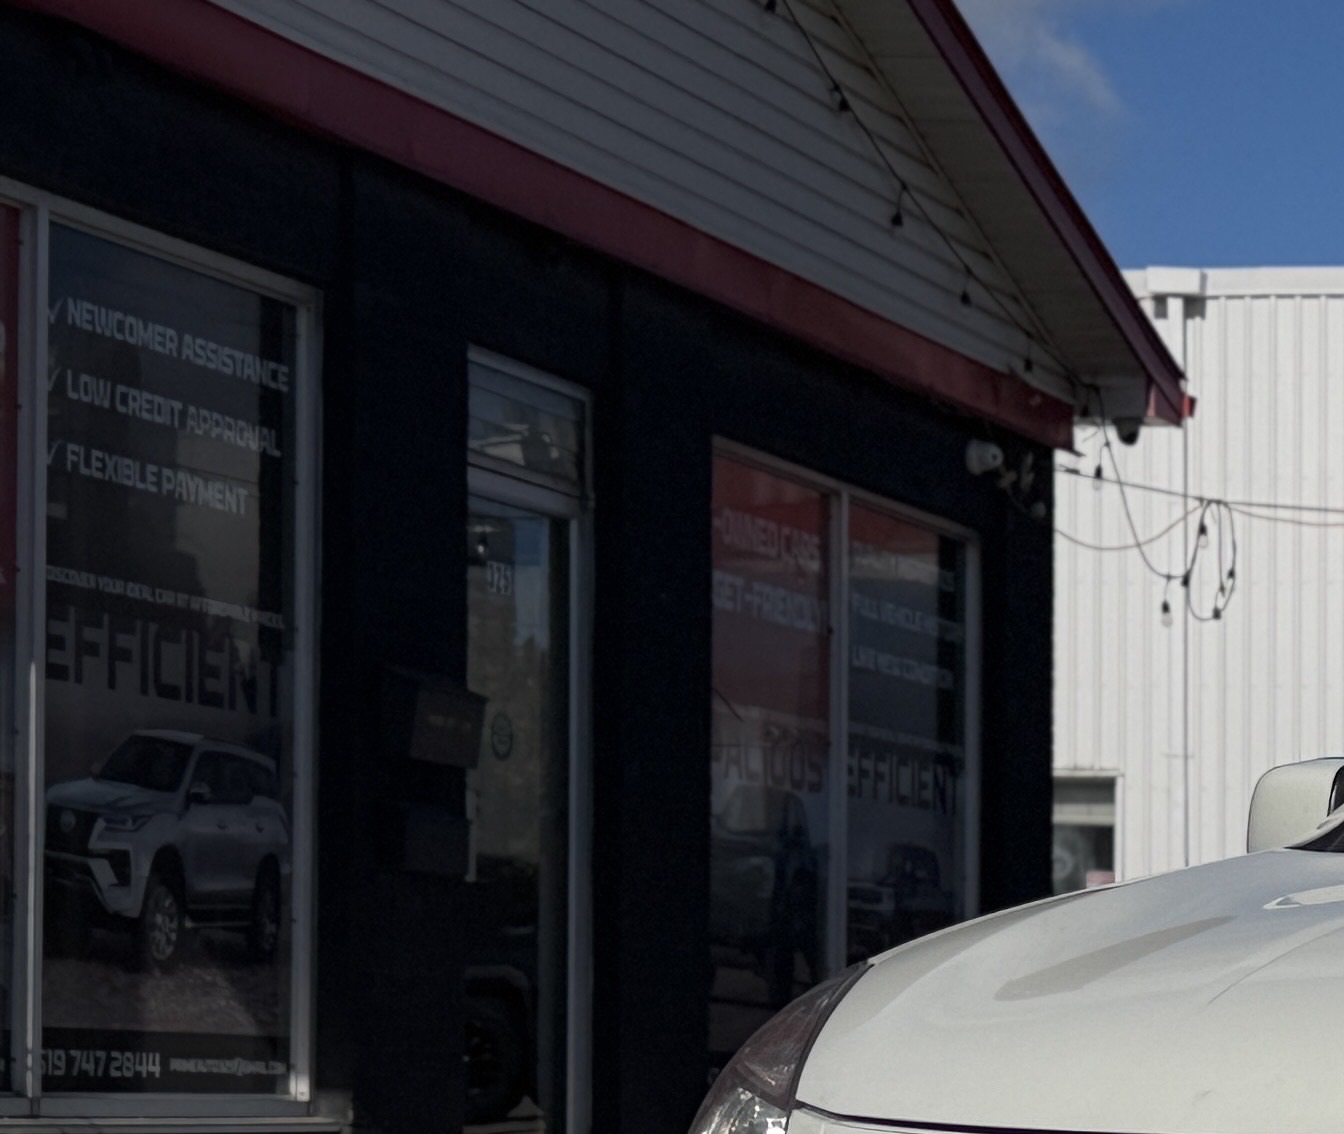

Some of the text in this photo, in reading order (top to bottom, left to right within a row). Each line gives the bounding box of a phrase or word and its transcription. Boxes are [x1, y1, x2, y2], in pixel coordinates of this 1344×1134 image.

[67, 296, 179, 358] NEWCOMER
[182, 333, 289, 394] ASSISTANCE
[66, 369, 281, 458] LOW CREDIT APPROVAL
[65, 443, 249, 516] FLEXIBLE PAYMENT
[46, 605, 288, 717] EFFICIENT
[69, 1049, 107, 1077] 747
[109, 1051, 161, 1079] 2844
